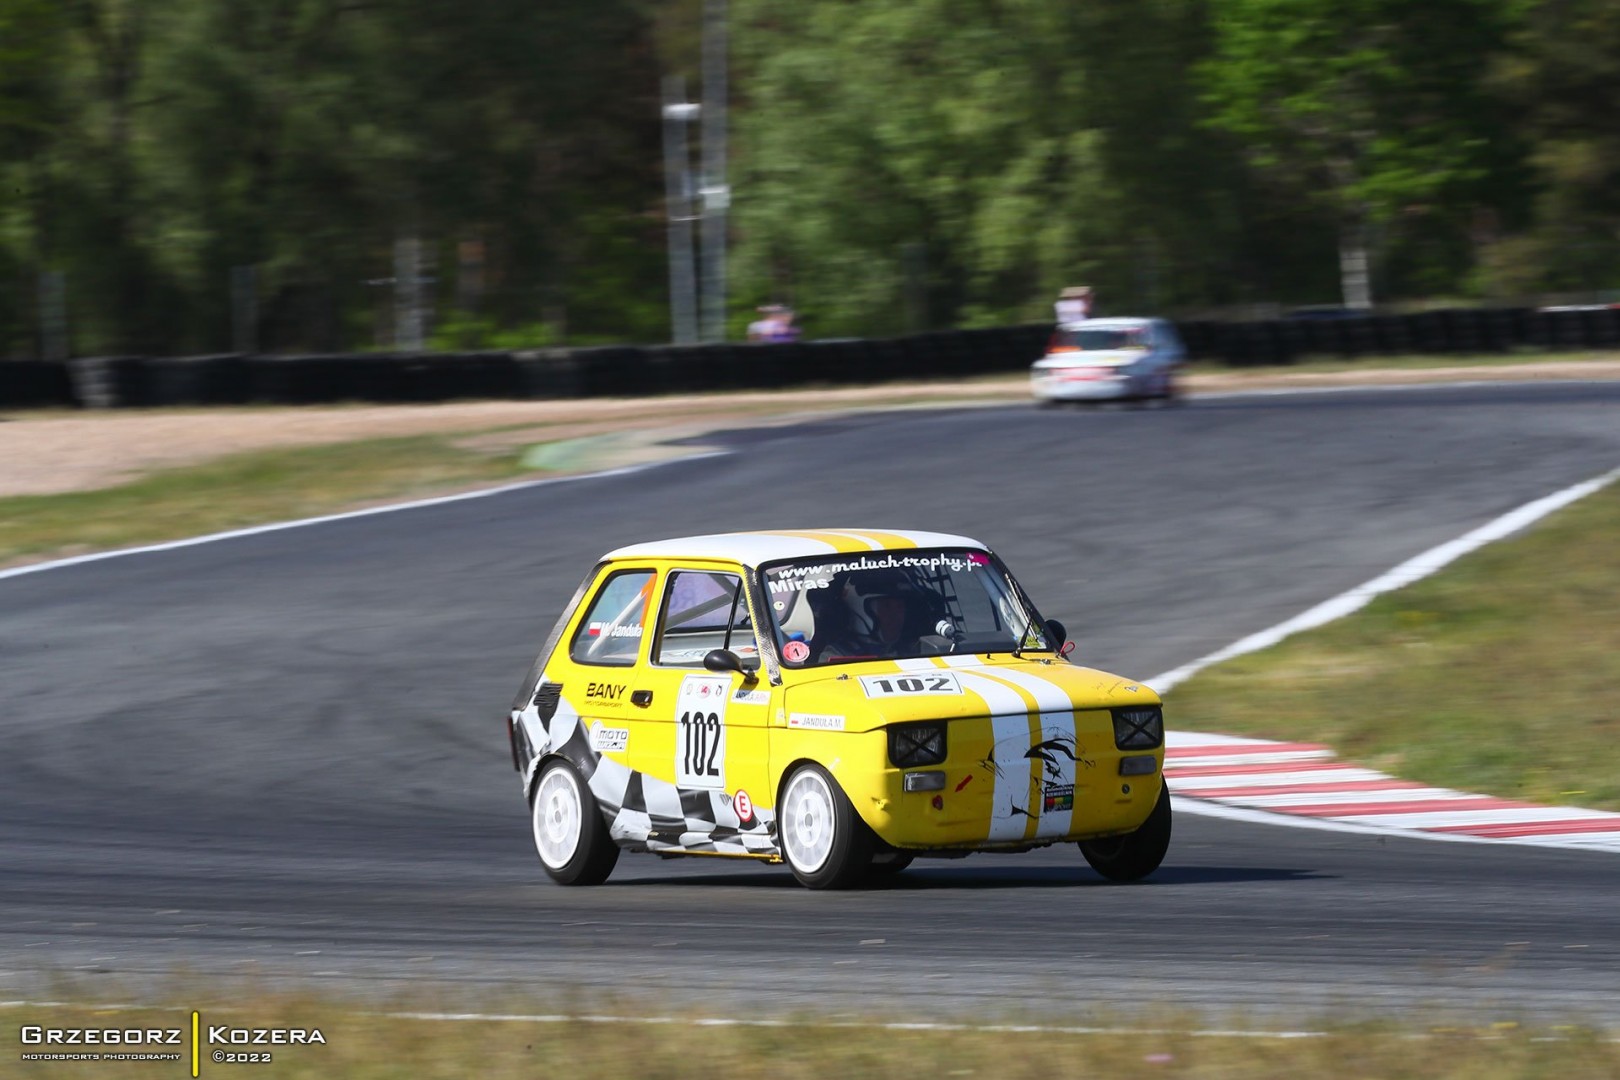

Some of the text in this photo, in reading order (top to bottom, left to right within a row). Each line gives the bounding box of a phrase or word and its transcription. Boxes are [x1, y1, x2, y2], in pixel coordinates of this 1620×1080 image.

[768, 578, 830, 594] Miras
[586, 683, 627, 700] BANY
[873, 678, 953, 693] 102
[680, 711, 721, 776] 102
[738, 794, 748, 814] E
